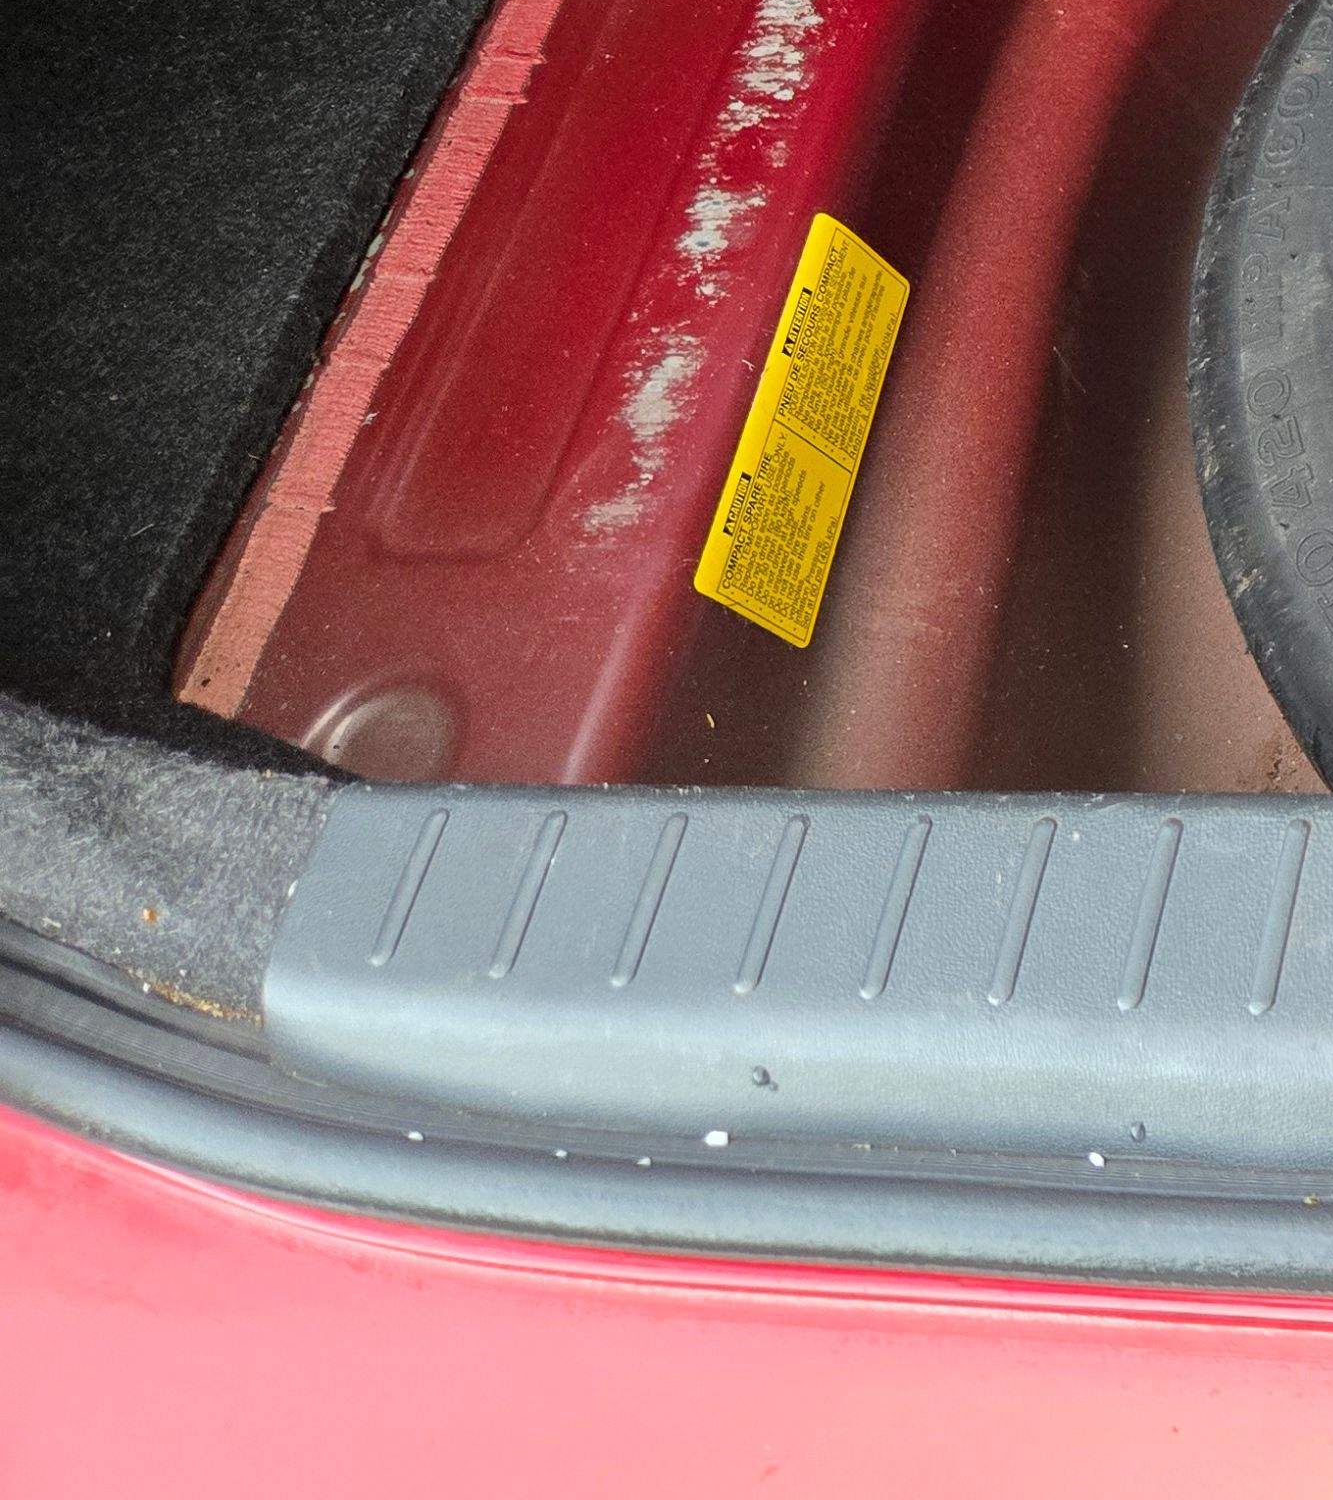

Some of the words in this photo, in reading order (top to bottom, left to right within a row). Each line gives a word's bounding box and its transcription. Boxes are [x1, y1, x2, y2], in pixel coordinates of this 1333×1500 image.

[777, 380, 794, 417] PNEU
[789, 361, 801, 382] DE
[796, 301, 820, 363] SECOURS
[815, 245, 839, 303] COMPACT
[787, 289, 810, 342] ATTENTION
[728, 476, 749, 522] CAUTION
[1247, 366, 1316, 523] 420
[721, 524, 748, 590] COMPACT
[742, 481, 762, 525] SPARE
[757, 451, 772, 482] TIRE
[732, 563, 745, 590] FOR
[742, 488, 769, 558] TEMPORARY
[764, 463, 777, 489] USE
